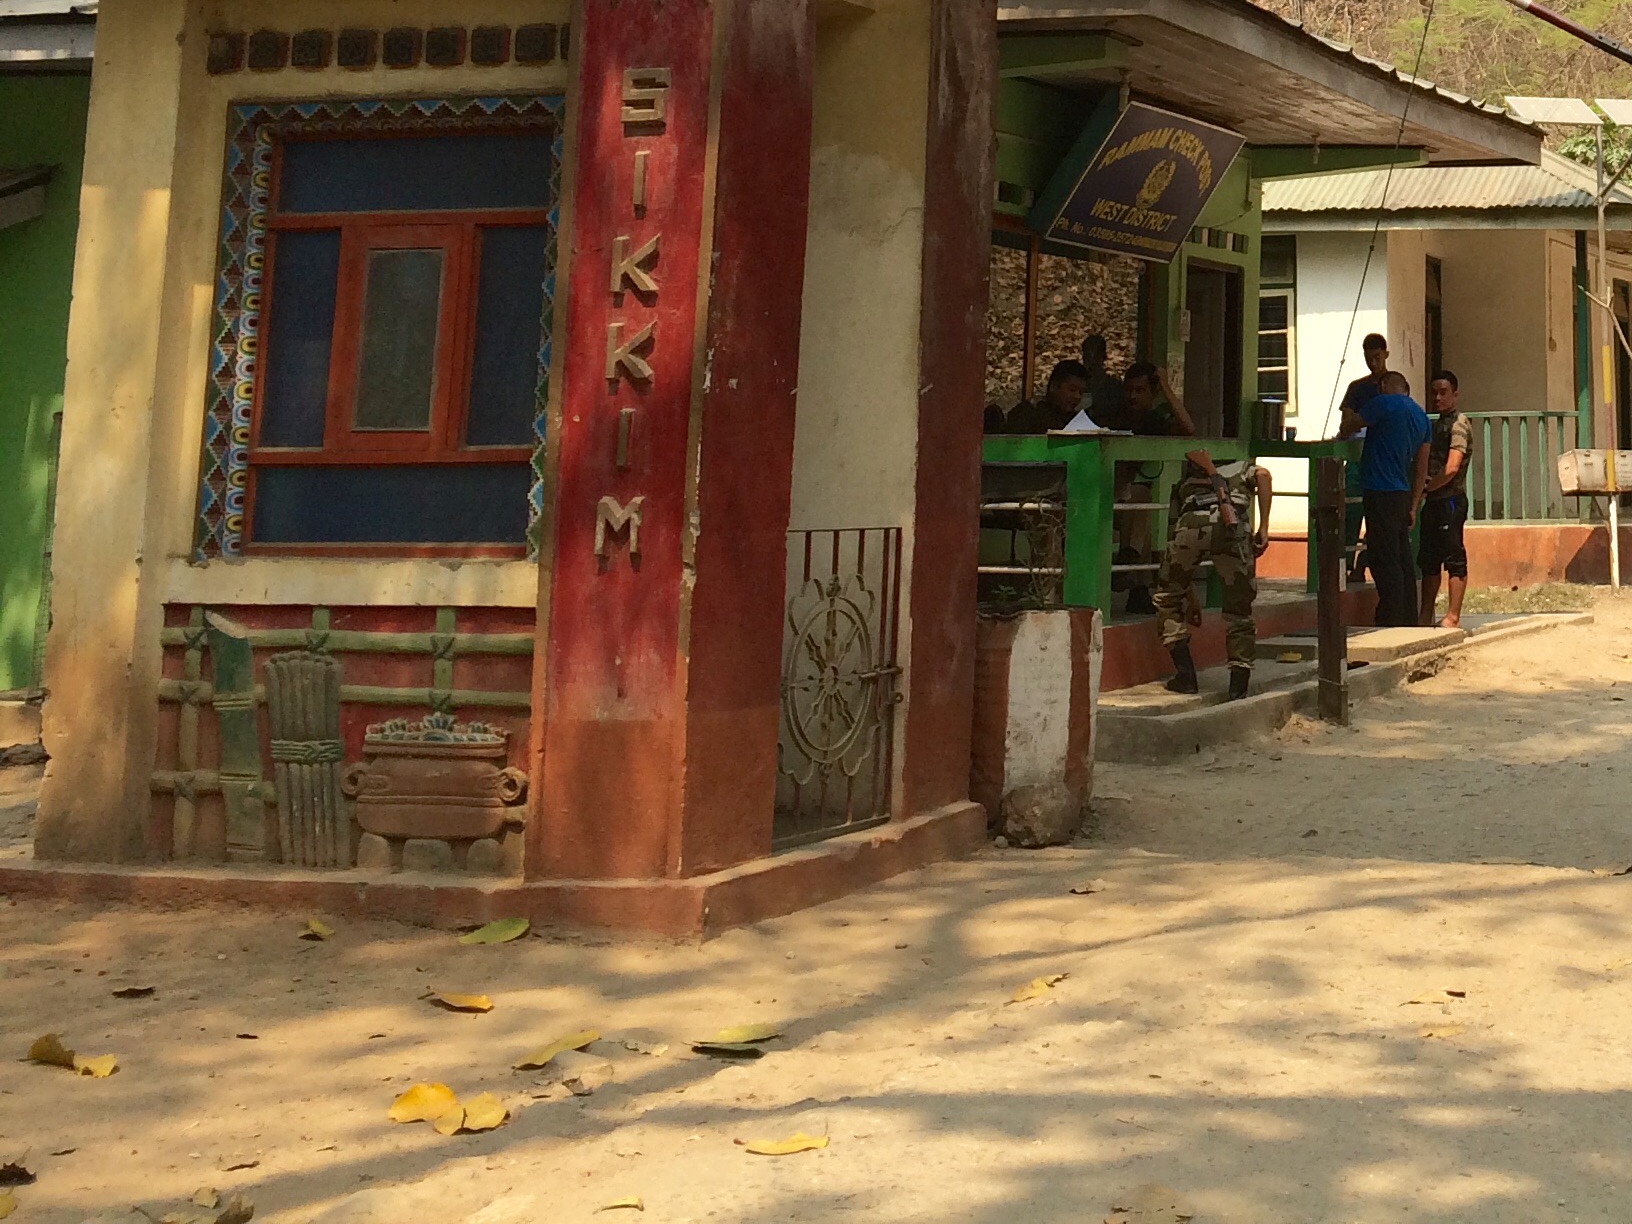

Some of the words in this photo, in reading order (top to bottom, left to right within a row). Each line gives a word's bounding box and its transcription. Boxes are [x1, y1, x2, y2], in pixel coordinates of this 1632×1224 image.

[1169, 128, 1205, 166] CHECK
[1090, 198, 1130, 223] WEST
[1123, 207, 1178, 233] DISTRICT
[594, 67, 671, 562] SIKKIM
